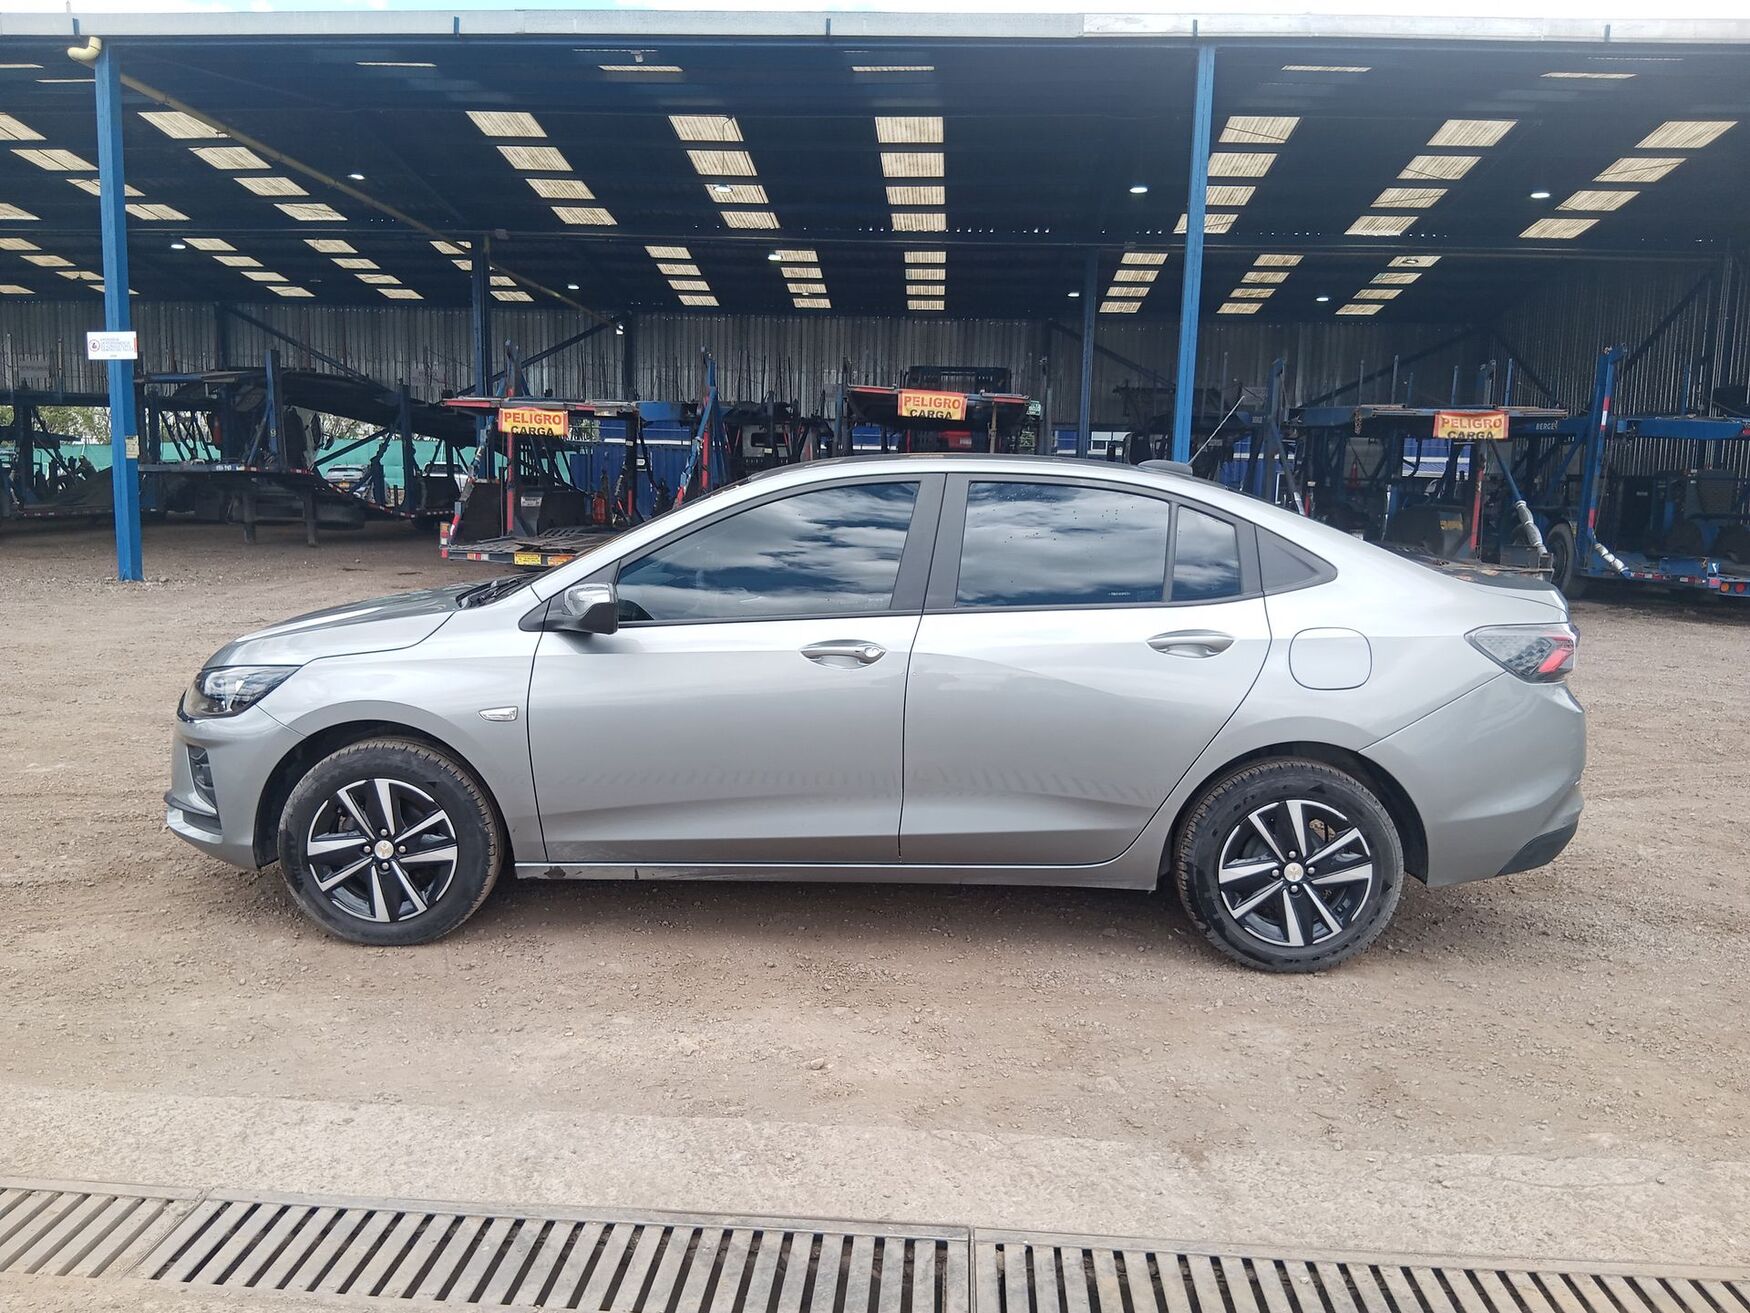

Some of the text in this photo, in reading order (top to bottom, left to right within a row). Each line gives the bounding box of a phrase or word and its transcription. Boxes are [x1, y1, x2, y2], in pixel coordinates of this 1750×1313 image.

[903, 396, 961, 409] PELIGRO
[504, 412, 562, 425] PELIGRO
[909, 409, 953, 419] CARGA
[1441, 417, 1503, 429] PELIGRO
[510, 425, 555, 436] CARGA
[1447, 430, 1494, 439] CARGA
